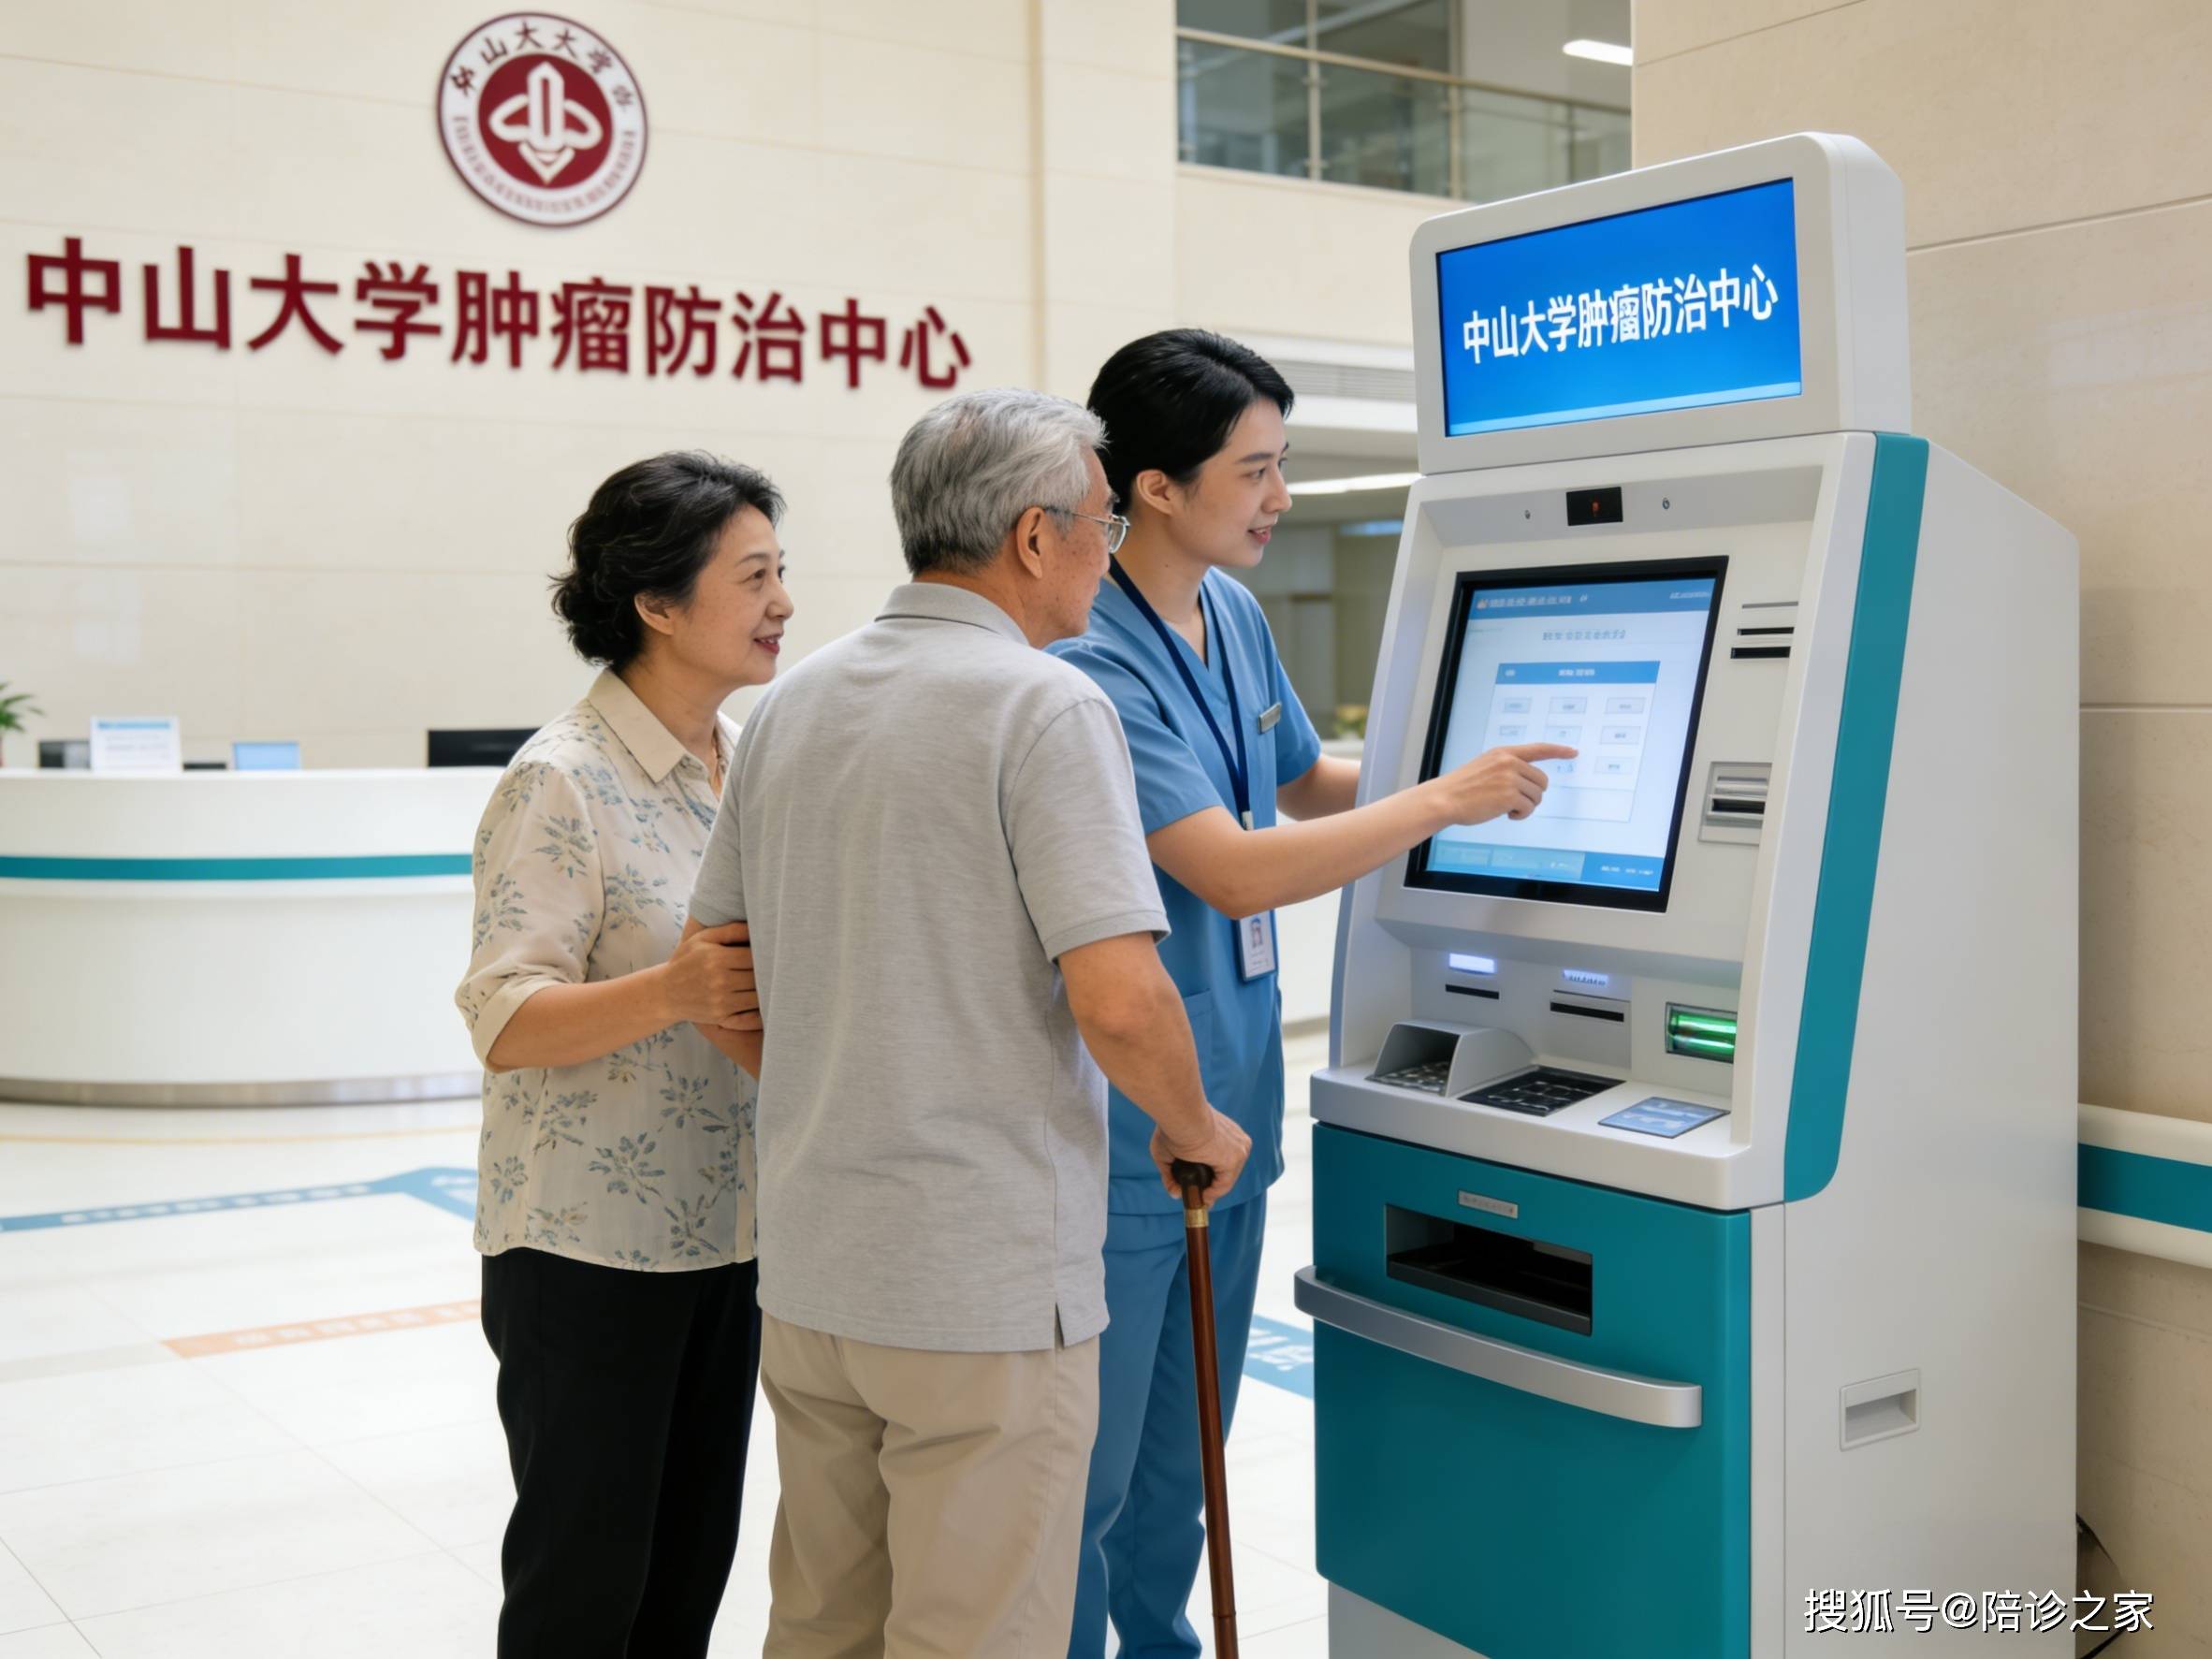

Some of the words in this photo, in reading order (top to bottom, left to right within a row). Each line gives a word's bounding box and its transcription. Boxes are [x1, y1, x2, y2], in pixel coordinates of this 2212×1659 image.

[27, 237, 971, 389] 中山大学肿瘤防治中心
[1463, 263, 1779, 364] 中山大学肿瘤防治中心
